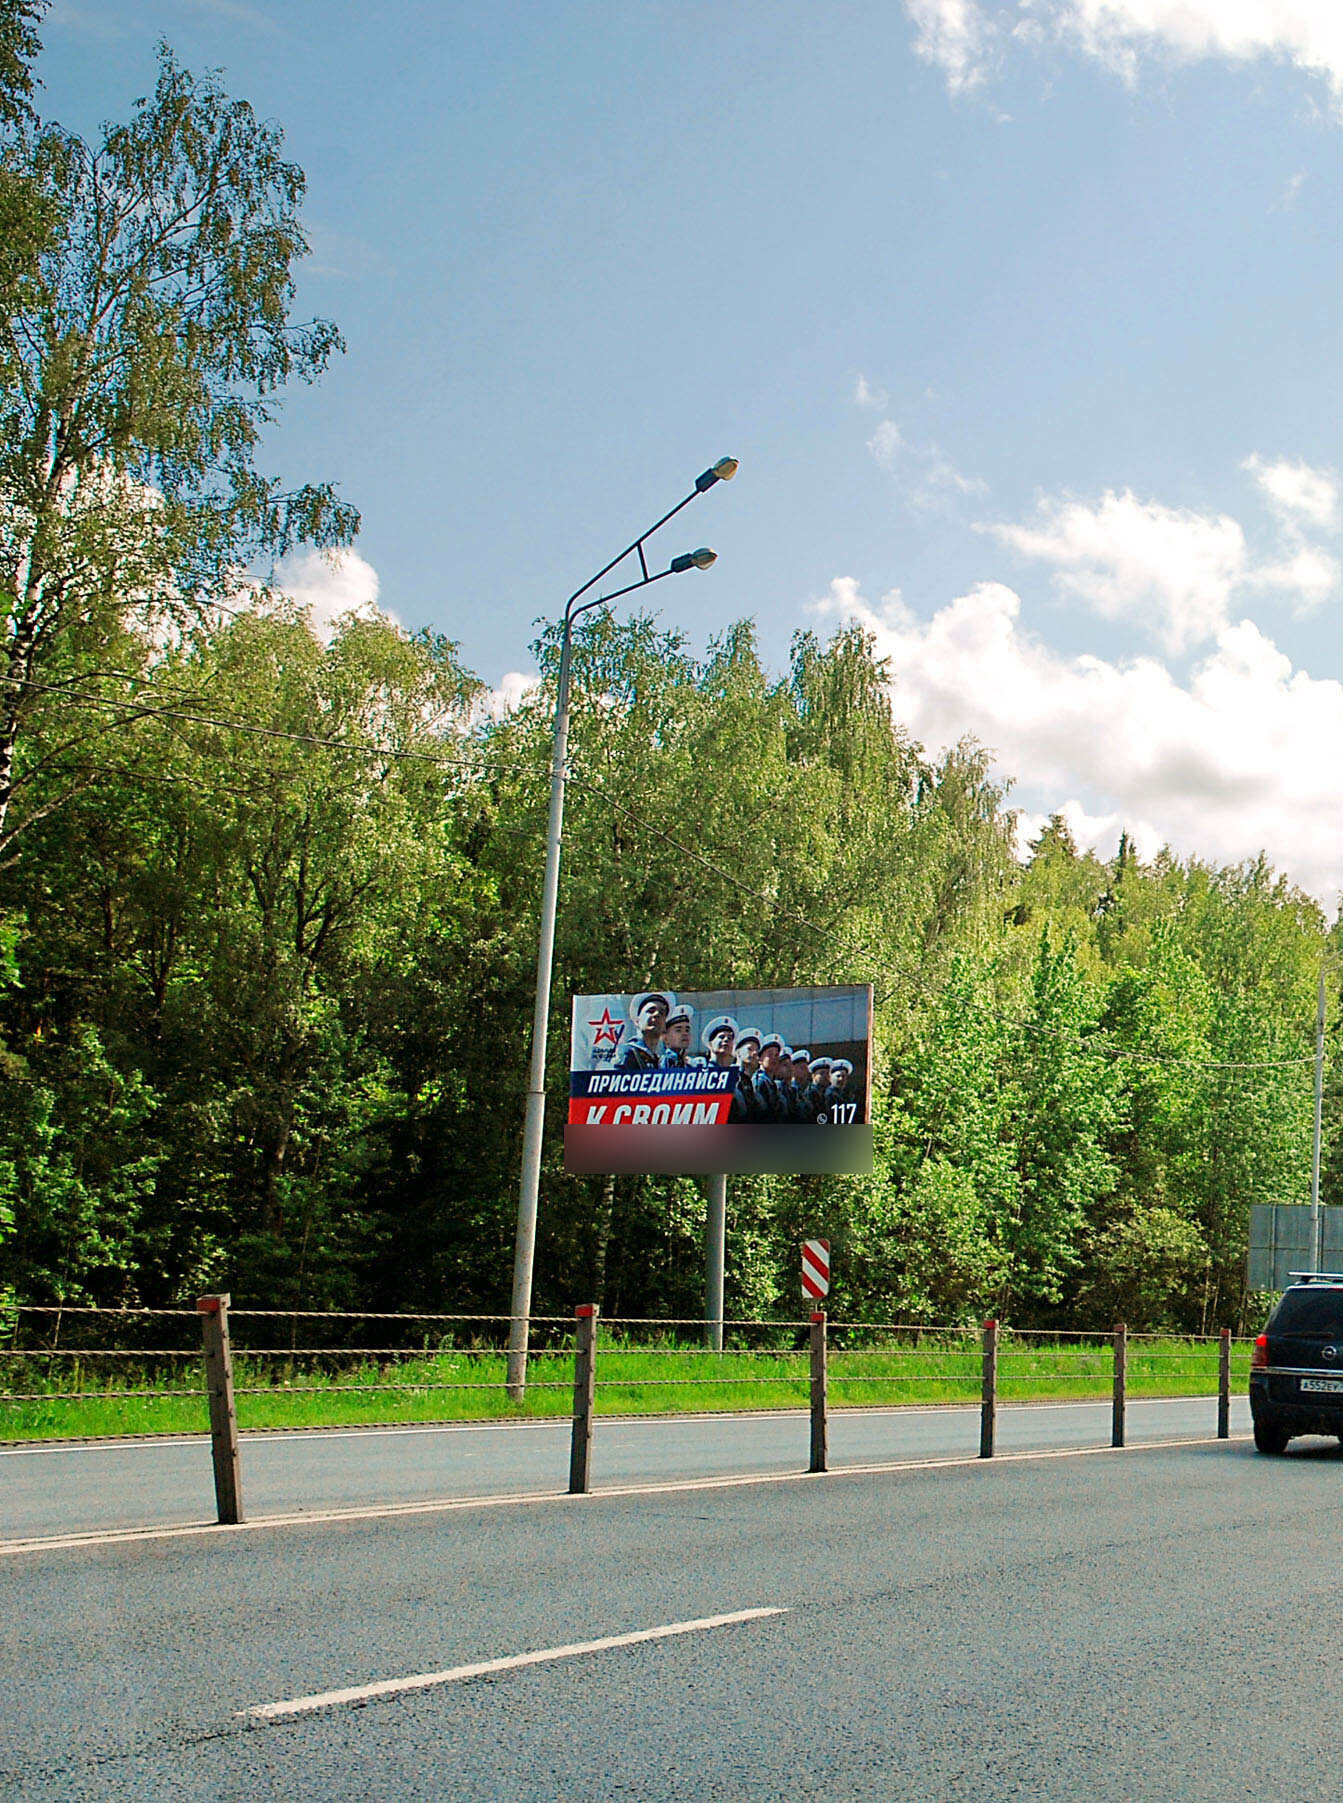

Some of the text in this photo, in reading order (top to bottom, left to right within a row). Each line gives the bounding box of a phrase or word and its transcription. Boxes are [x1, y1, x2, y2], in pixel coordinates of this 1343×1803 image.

[588, 1068, 729, 1093] ПРИСОЕДИНЯЙСЯ
[586, 1102, 720, 1124] К СВОИМ
[831, 1103, 857, 1124] 117
